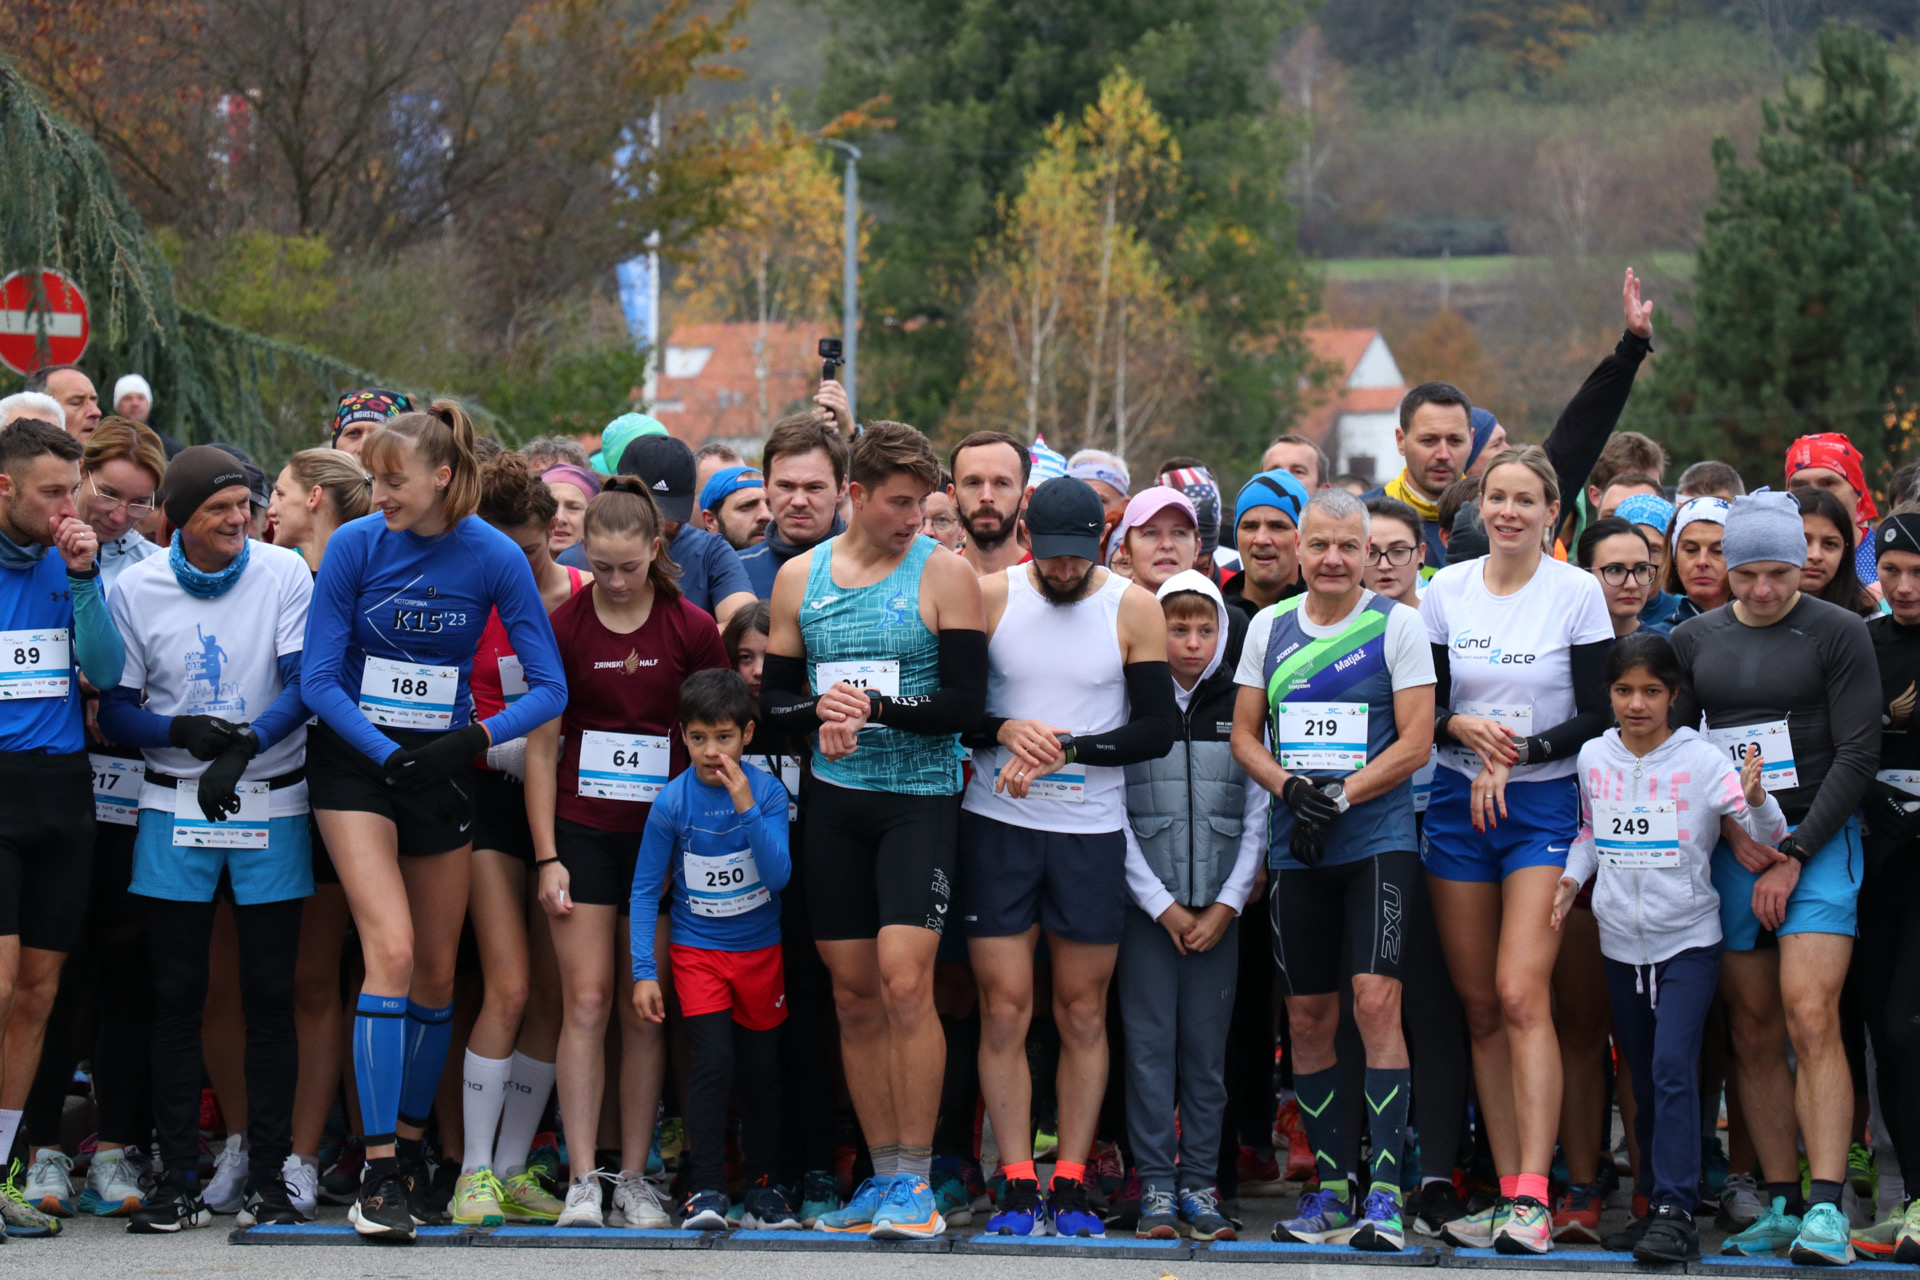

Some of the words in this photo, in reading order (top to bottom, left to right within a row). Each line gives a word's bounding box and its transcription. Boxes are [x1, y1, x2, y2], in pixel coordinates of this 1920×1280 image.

[1453, 628, 1492, 649] Fund
[14, 647, 40, 665] 89
[593, 660, 624, 669] ZRINSKI
[639, 658, 659, 667] HALF
[1334, 648, 1367, 672] Matjaž
[1488, 648, 1536, 665] Race
[391, 677, 428, 697] 188
[1304, 719, 1337, 736] 219
[613, 750, 639, 768] 64
[704, 809, 735, 817] KIPSTA
[1612, 818, 1649, 835] 249
[705, 867, 744, 887] 250
[1381, 882, 1402, 965] 2XU
